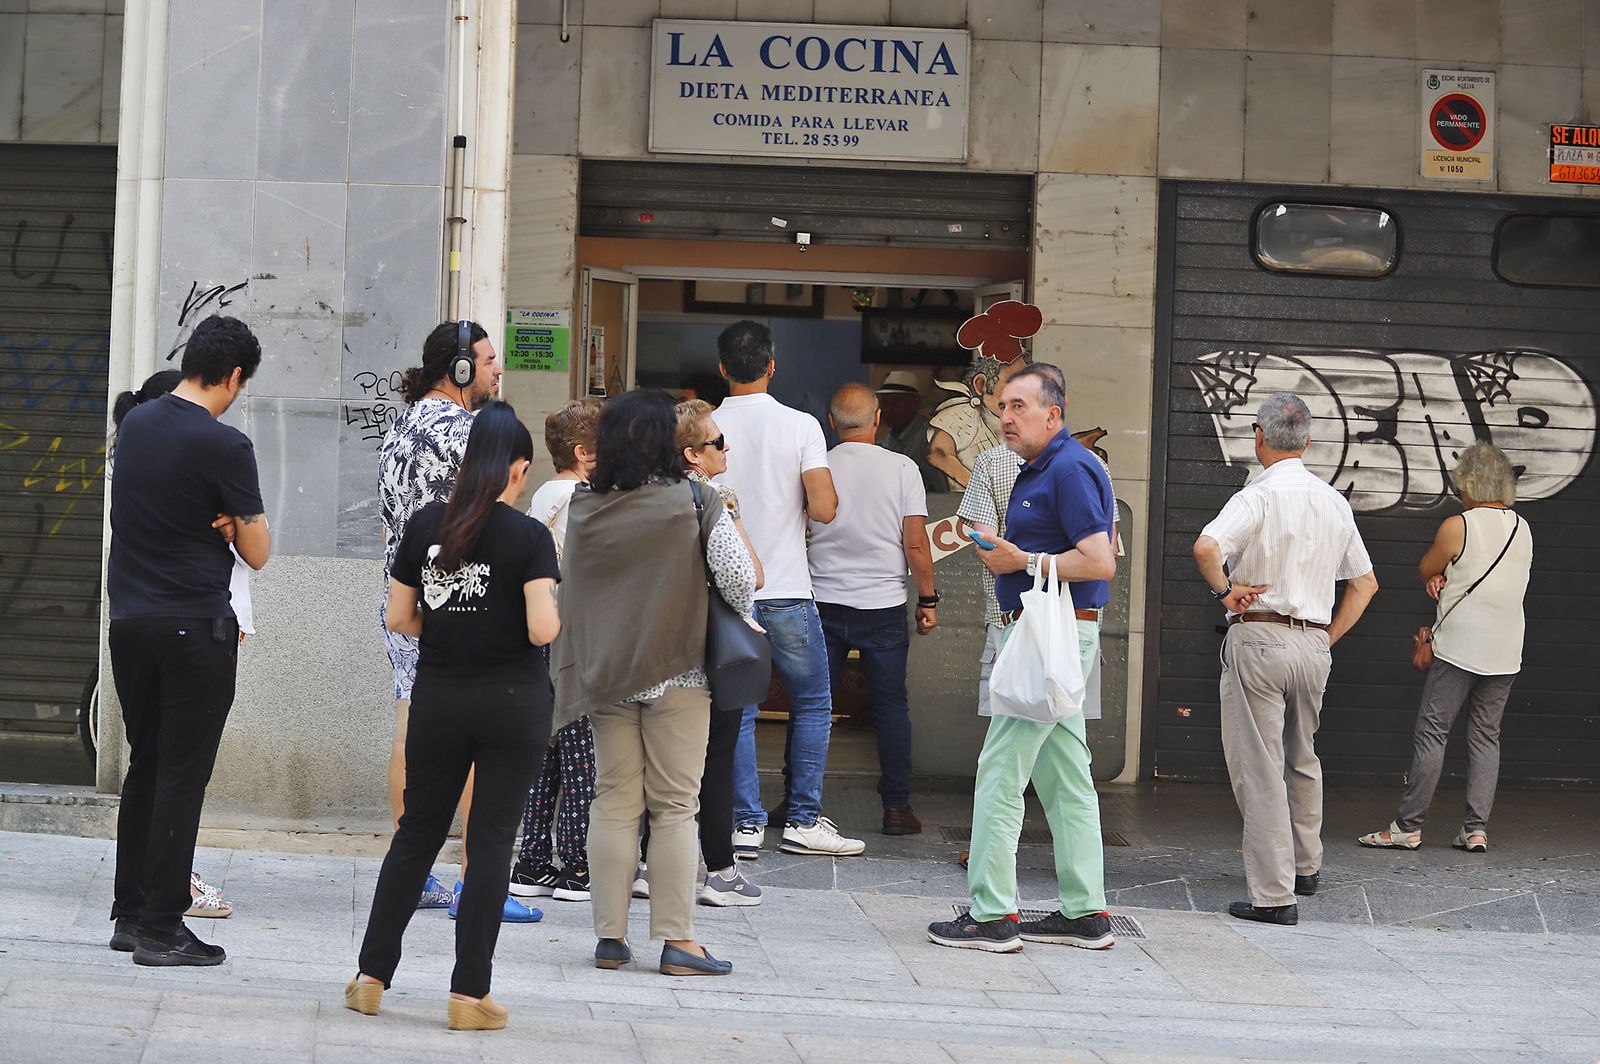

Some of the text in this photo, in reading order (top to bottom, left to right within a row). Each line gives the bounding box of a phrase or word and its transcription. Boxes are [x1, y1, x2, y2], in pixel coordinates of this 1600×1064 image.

[666, 32, 959, 76] LA COCINA
[679, 81, 951, 107] DIETA MEDITERRANEA
[713, 113, 909, 132] COMIDA PARA LLEVAR
[1436, 120, 1480, 129] PERMANENTE
[762, 132, 860, 147] TEL. 28 53 99
[1552, 126, 1569, 144] SE
[1456, 156, 1481, 164] MUNICIPAL
[1557, 148, 1583, 161] PLAZA
[1447, 165, 1464, 173] 1050
[514, 335, 530, 343] 9:00
